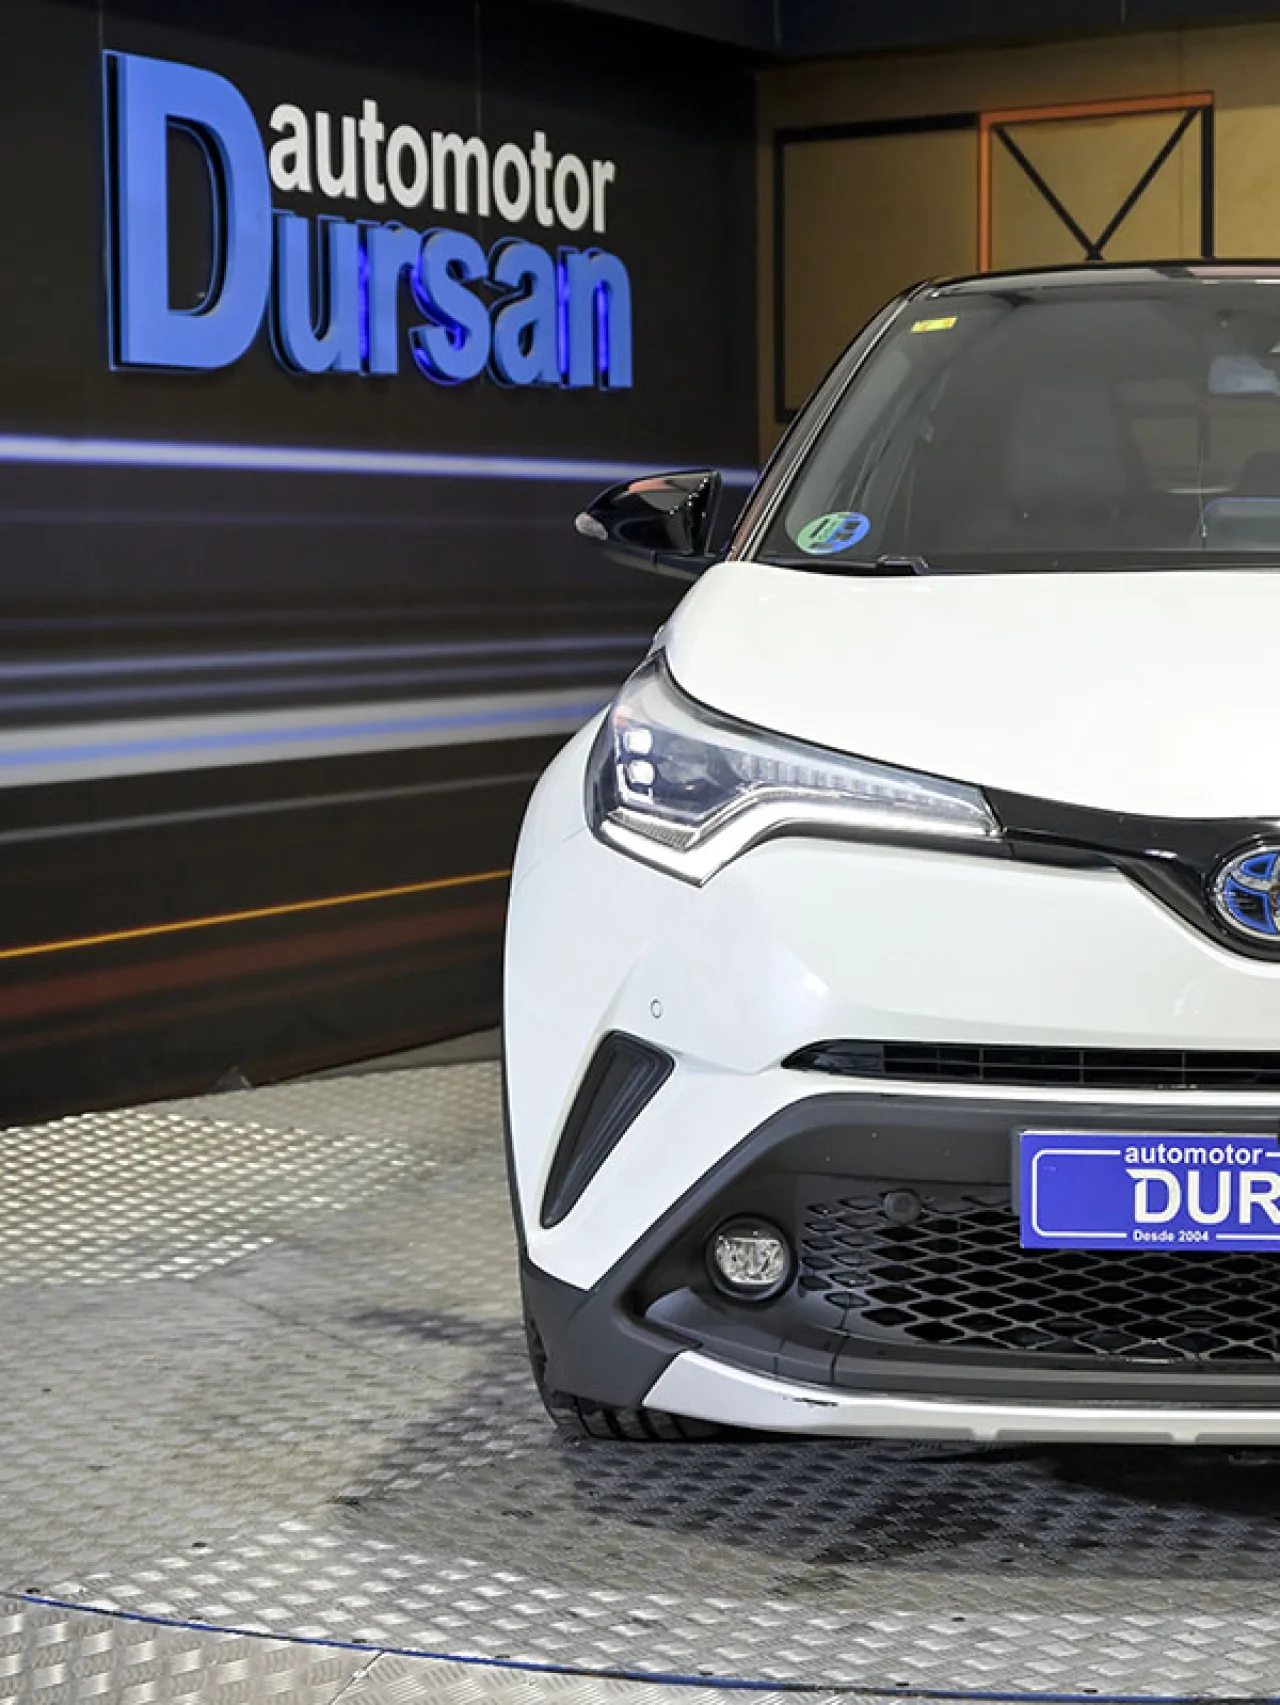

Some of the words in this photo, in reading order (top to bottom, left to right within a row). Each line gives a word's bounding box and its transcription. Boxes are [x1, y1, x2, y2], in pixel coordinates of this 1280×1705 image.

[268, 98, 616, 234] automotor
[102, 48, 634, 391] Dursan
[1123, 1143, 1264, 1165] automotor
[1132, 1228, 1175, 1243] Desde
[1178, 1229, 1209, 1243] 2004
